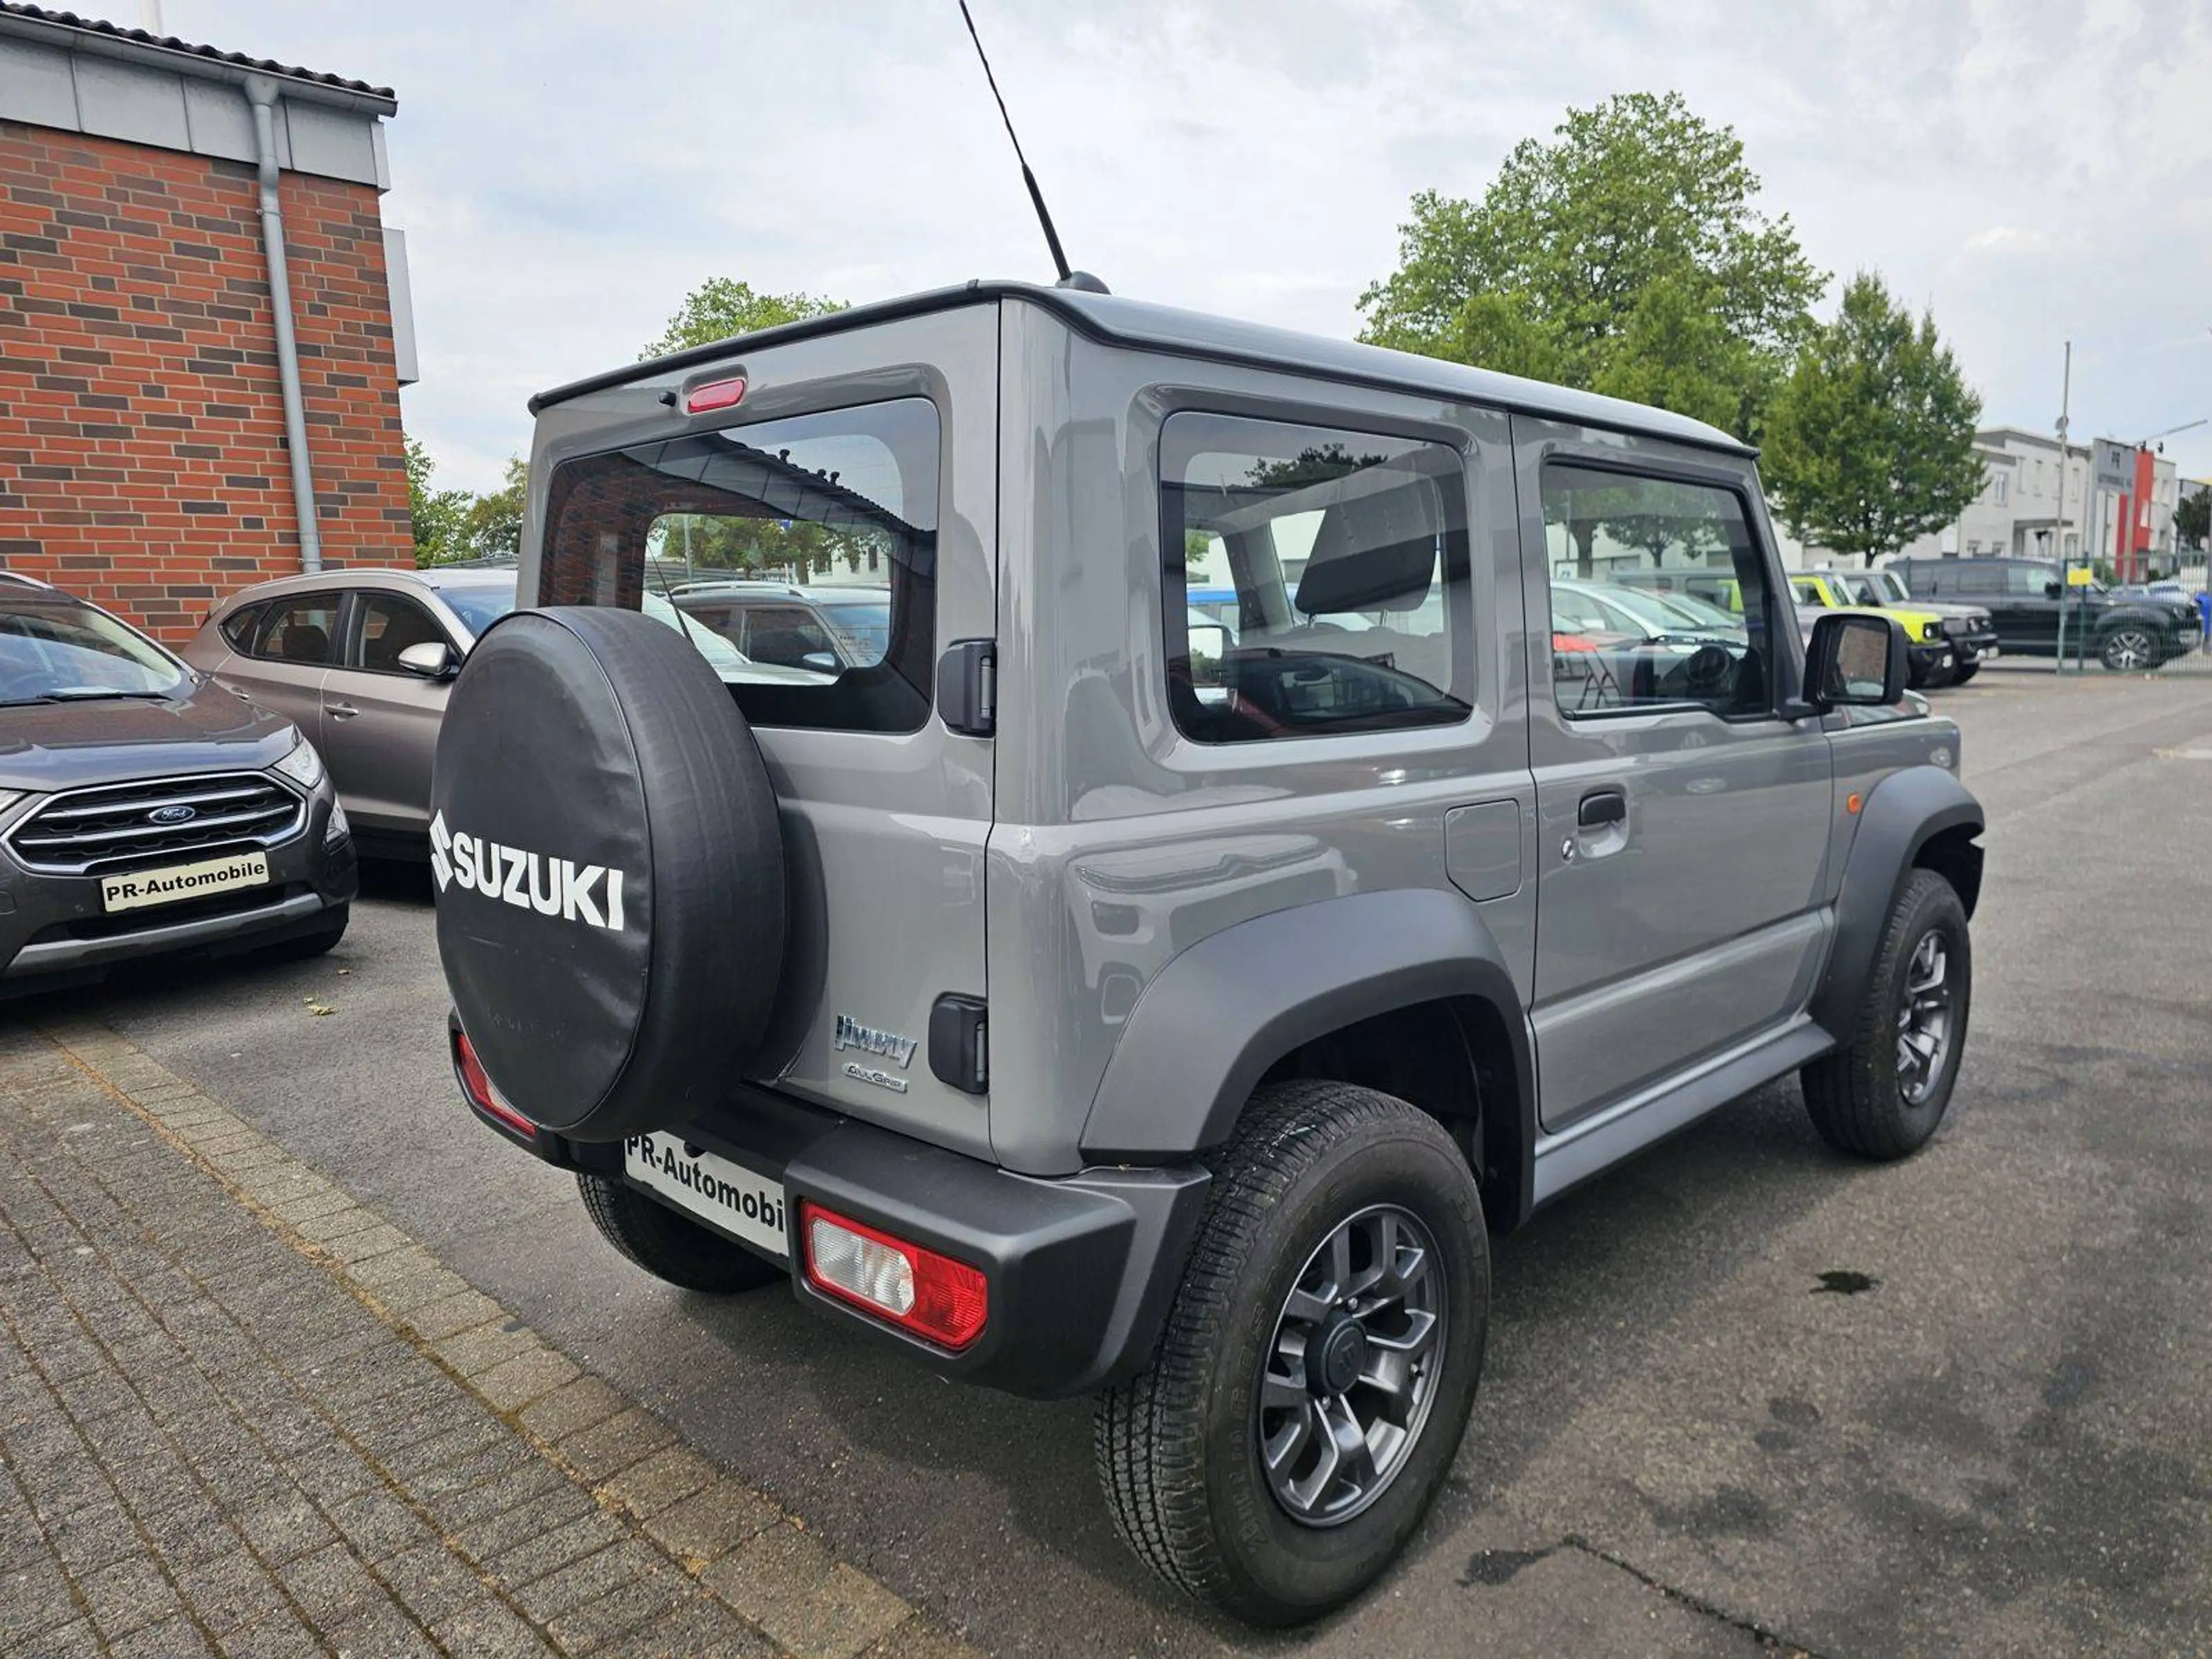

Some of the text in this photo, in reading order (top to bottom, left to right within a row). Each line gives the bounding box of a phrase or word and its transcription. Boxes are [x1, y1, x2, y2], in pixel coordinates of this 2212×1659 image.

[161, 808, 187, 820] Ford
[106, 862, 266, 902] PR-Automobile
[453, 832, 624, 931] SUZUKI
